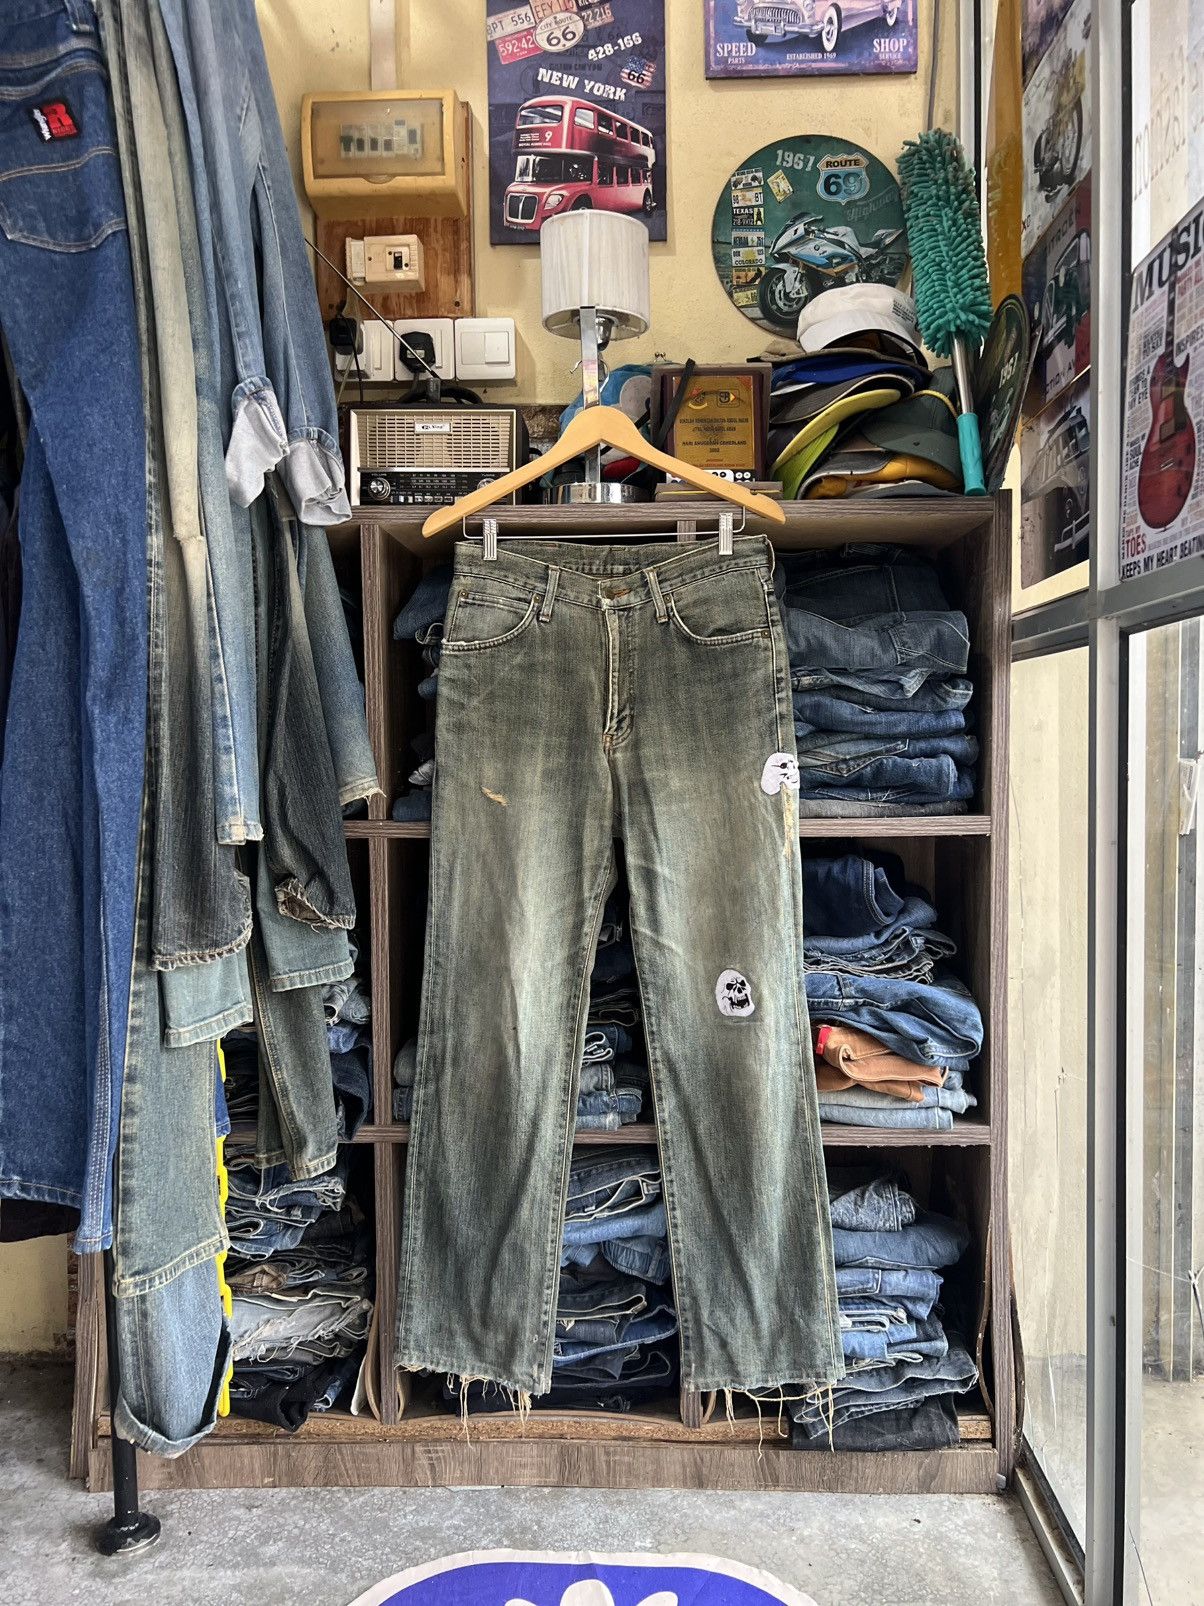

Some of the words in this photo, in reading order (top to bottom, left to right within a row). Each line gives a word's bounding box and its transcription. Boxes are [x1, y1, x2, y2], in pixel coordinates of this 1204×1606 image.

[511, 12, 531, 26] 556
[588, 32, 643, 61] 428-166
[716, 42, 756, 57] SPEED
[873, 38, 907, 53] SHOP
[537, 68, 579, 89] NEW
[584, 79, 627, 101] YORK
[627, 69, 645, 84] 66
[544, 131, 553, 142] 9
[776, 149, 815, 172] 1967
[825, 159, 860, 168] ROUTE
[823, 172, 863, 196] 69
[734, 258, 762, 266] COLORADO
[1132, 209, 1204, 313] MUSI
[1126, 532, 1147, 558] TOES
[1121, 560, 1141, 580] KEEPS
[1143, 554, 1154, 572] MY
[1156, 545, 1178, 568] HEART
